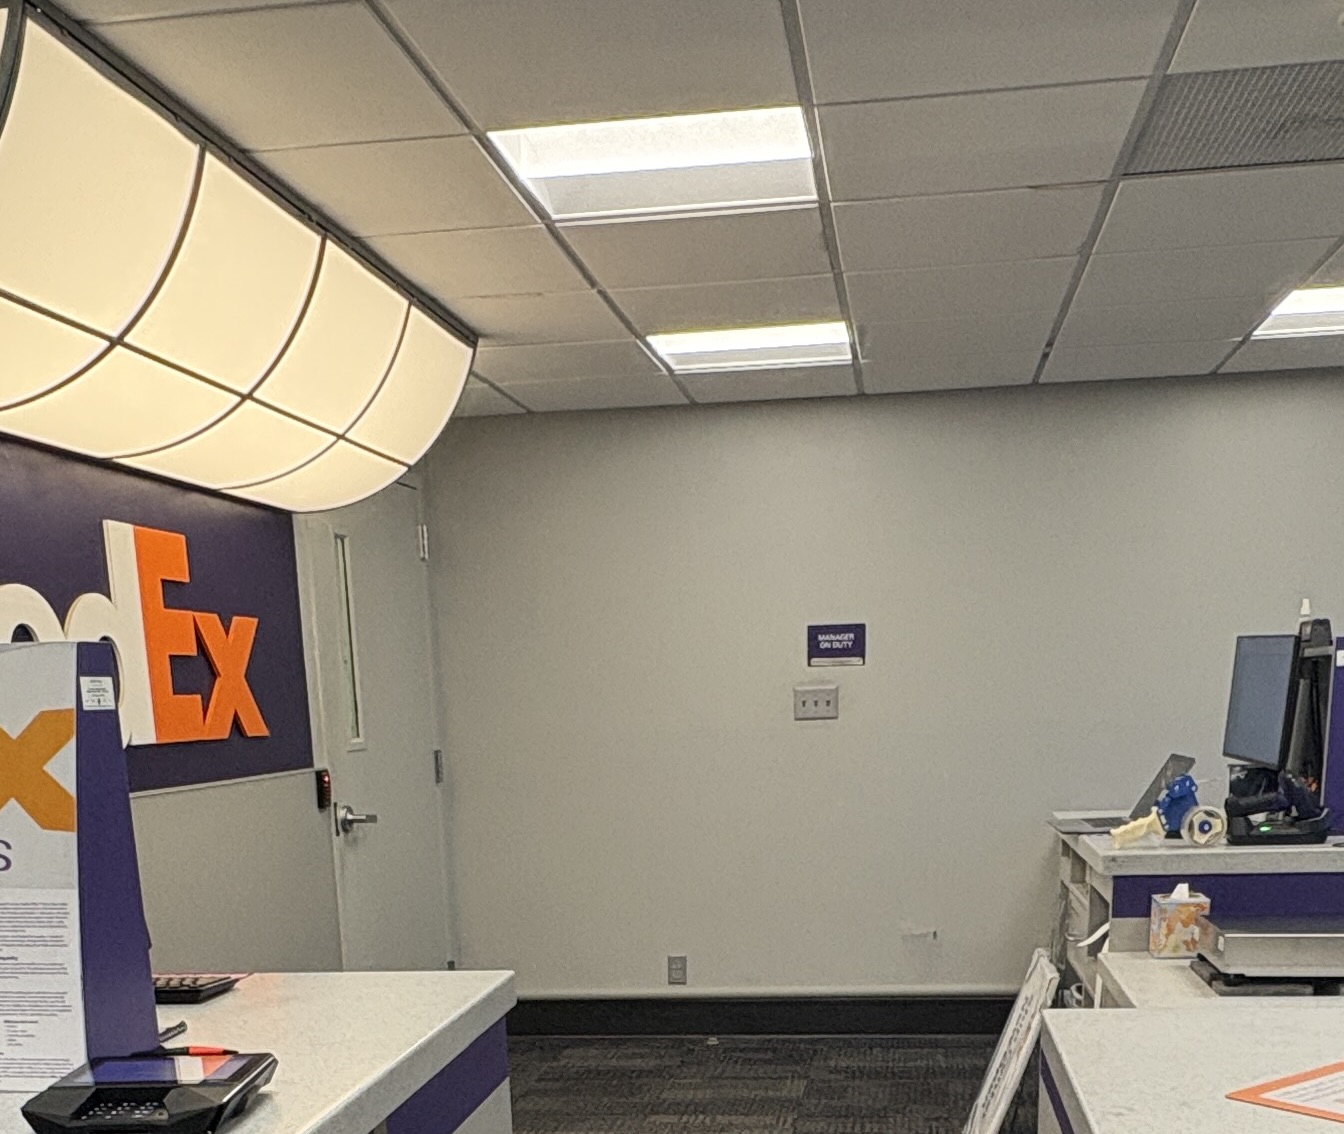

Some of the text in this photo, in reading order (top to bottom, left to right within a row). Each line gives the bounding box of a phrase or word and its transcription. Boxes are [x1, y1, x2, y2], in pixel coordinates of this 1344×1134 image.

[818, 633, 855, 641] MANAGER
[819, 640, 853, 649] ON DUTY
